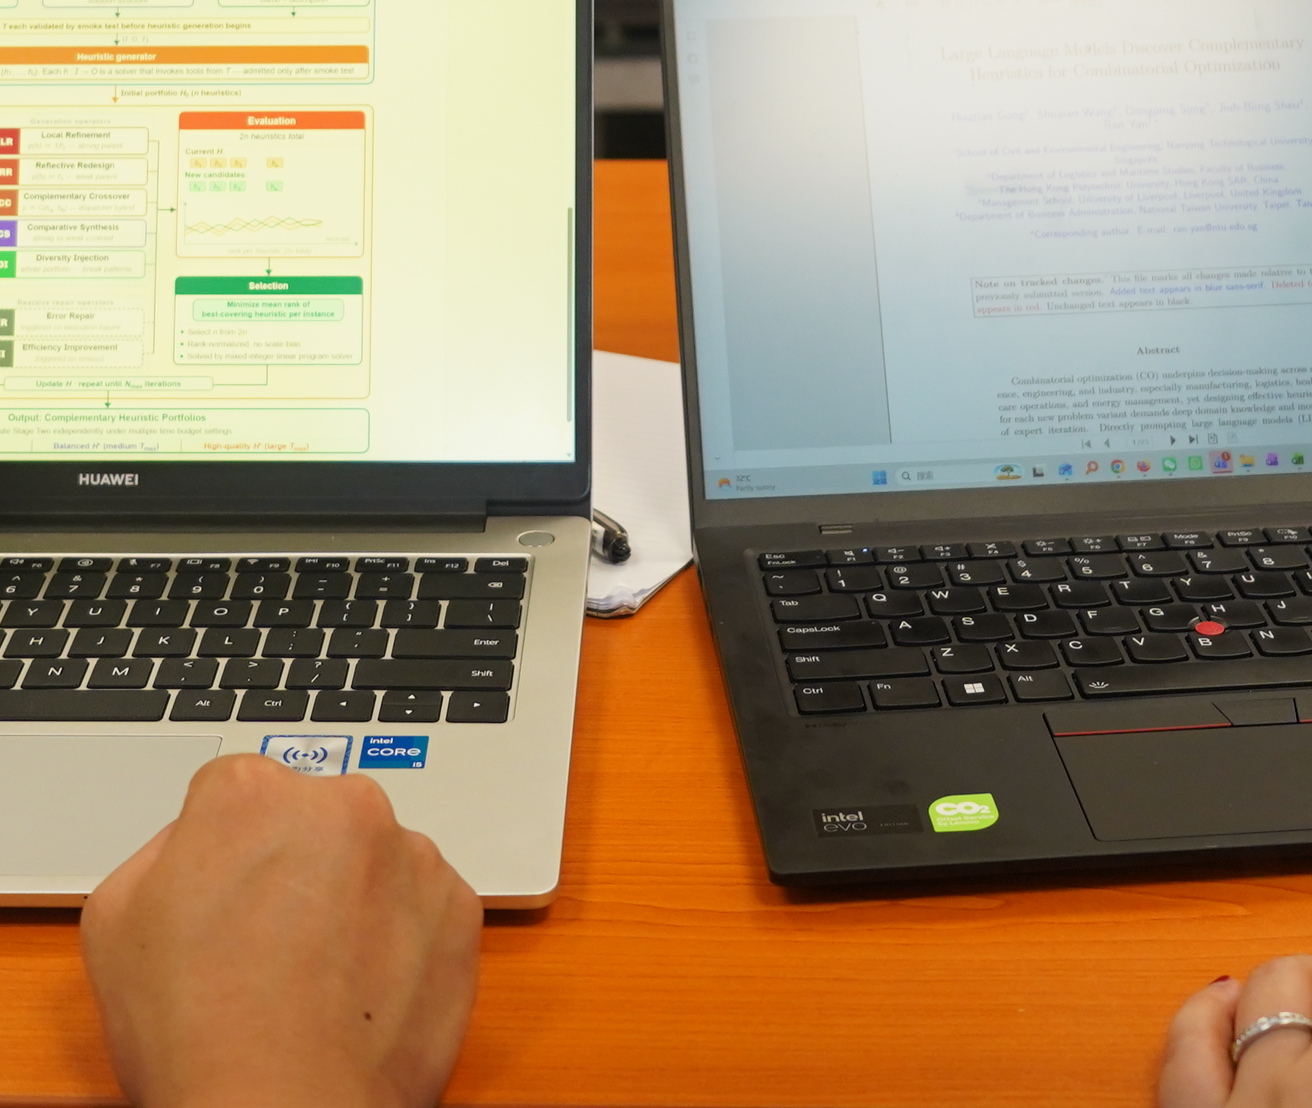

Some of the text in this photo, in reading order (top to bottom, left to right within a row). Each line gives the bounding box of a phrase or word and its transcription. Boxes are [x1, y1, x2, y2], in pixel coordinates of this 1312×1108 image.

[66, 23, 75, 32] by
[183, 22, 224, 31] generation
[226, 22, 251, 30] begins
[941, 38, 1304, 63] Large Language Models Discover Complementary
[77, 52, 157, 62] Heuristic generator
[970, 60, 1280, 82] Heuristics for Combinatorial Optimization
[145, 89, 178, 98] portfolio
[201, 89, 241, 97] heuristics)
[248, 117, 296, 125] Evaluation
[0, 138, 13, 146] LR
[77, 162, 115, 170] Redesign
[23, 193, 86, 201] Complementary
[36, 254, 109, 263] Diversity Injection
[1196, 271, 1230, 281] changes
[1234, 270, 1257, 278] made
[1261, 269, 1292, 277] relative
[249, 282, 288, 291] Selection
[975, 280, 999, 288] Note
[1021, 278, 1057, 286] tracked
[1062, 276, 1104, 286] changes.
[1110, 287, 1135, 295] Added
[1160, 284, 1191, 294] appears
[1205, 282, 1222, 291] blue
[1226, 281, 1265, 291] sans-serif.
[1272, 280, 1304, 289] Deleted
[69, 312, 95, 321] Repair
[202, 310, 252, 318] best-covering
[23, 344, 118, 352] Efficiency Improvement
[1137, 346, 1180, 355] Abstract
[1011, 376, 1075, 385] Combinatorial
[1077, 373, 1133, 384] optimization
[1136, 371, 1159, 380] (CO)
[1162, 369, 1205, 379] underpins
[1208, 366, 1278, 377] decision-making
[1281, 366, 1307, 374] across
[36, 380, 63, 388] Update
[1098, 385, 1137, 395] industry,
[1140, 381, 1182, 393] especially
[1186, 380, 1252, 391] manufacturing,
[1255, 378, 1292, 389] logistics,
[1204, 392, 1245, 403] designing
[1248, 391, 1283, 399] effective
[8, 413, 206, 423] Output: Complementary Heuristic Portfolios
[1219, 416, 1257, 427] language
[1263, 415, 1292, 424] models
[54, 442, 89, 450] Balanced
[204, 442, 251, 451] High-quality
[79, 474, 138, 485] HUAWEI
[787, 625, 841, 634] CapsLock
[474, 638, 499, 646] Enter
[803, 687, 823, 695] Ctrl
[822, 811, 864, 823] intel
[823, 823, 867, 832] evo
